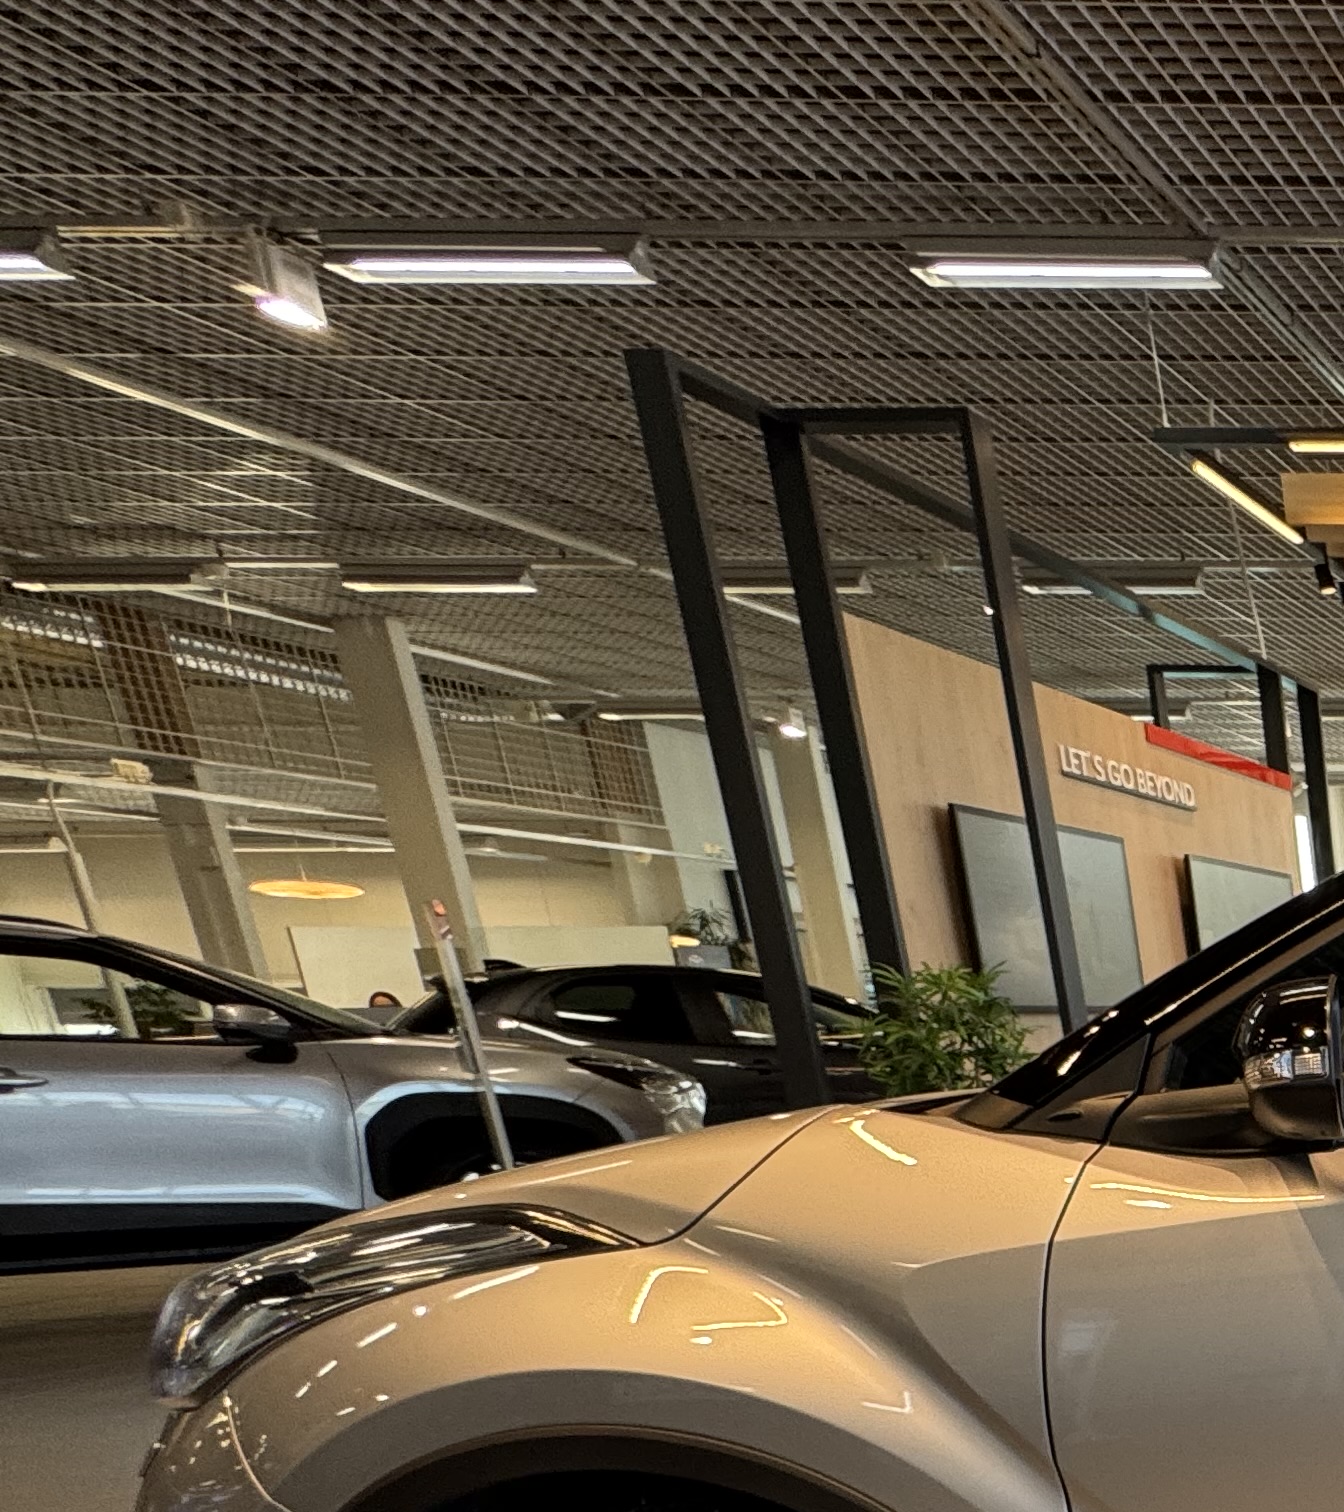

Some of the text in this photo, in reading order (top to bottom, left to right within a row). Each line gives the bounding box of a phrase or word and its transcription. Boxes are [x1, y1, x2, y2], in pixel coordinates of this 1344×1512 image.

[1057, 743, 1196, 807] LET'S GO BEYOND
